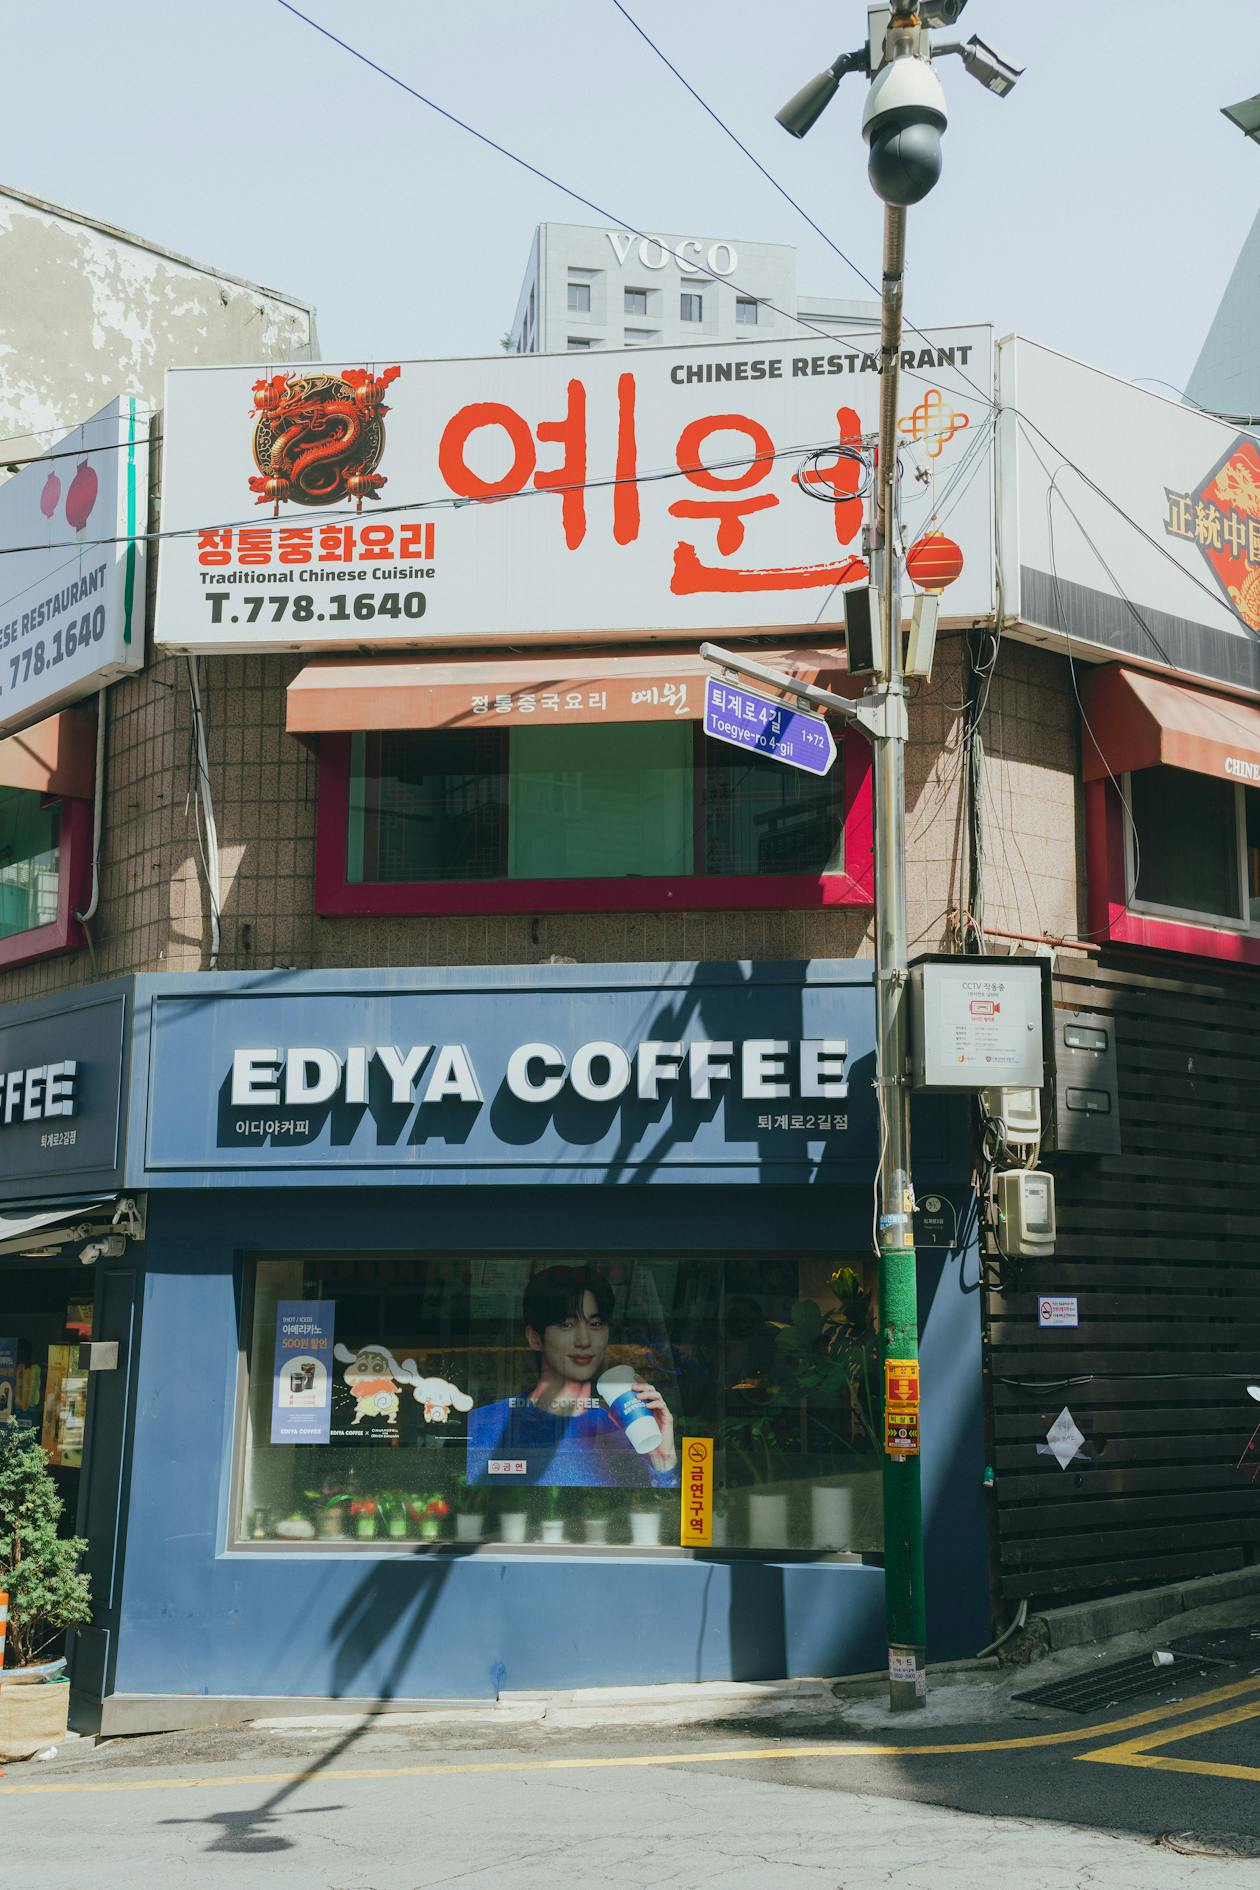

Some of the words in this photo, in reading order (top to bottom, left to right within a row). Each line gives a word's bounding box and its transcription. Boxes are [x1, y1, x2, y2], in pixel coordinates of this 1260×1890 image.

[669, 359, 784, 385] CHINESE
[791, 345, 973, 377] RESTARANT
[438, 372, 870, 596] 예원
[197, 522, 436, 567] 정통중화요리
[200, 569, 295, 585] Traditional
[299, 567, 367, 583] Chinese
[372, 565, 436, 580] Cuisine
[21, 563, 107, 637] RESTAURANT
[205, 591, 427, 624] T.778.1640
[471, 691, 607, 714] 정통중국요리
[711, 688, 782, 735] 퇴계로4길
[711, 713, 767, 746] Toegye-ro
[768, 736, 794, 757] 4-gil
[961, 982, 982, 990] CCTV
[231, 1044, 484, 1105] EDIYA
[506, 1040, 849, 1103] COFFEE
[0, 1060, 76, 1124] FEE
[41, 1130, 77, 1148] 퇴계로2길점
[236, 1119, 309, 1136] 이디야커피
[757, 1114, 849, 1131] 퇴계로2길점
[282, 1323, 323, 1336] 아메리카노
[282, 1338, 309, 1350] 500원
[550, 1397, 600, 1410] COFFEE
[690, 1465, 705, 1534] 금연구역
